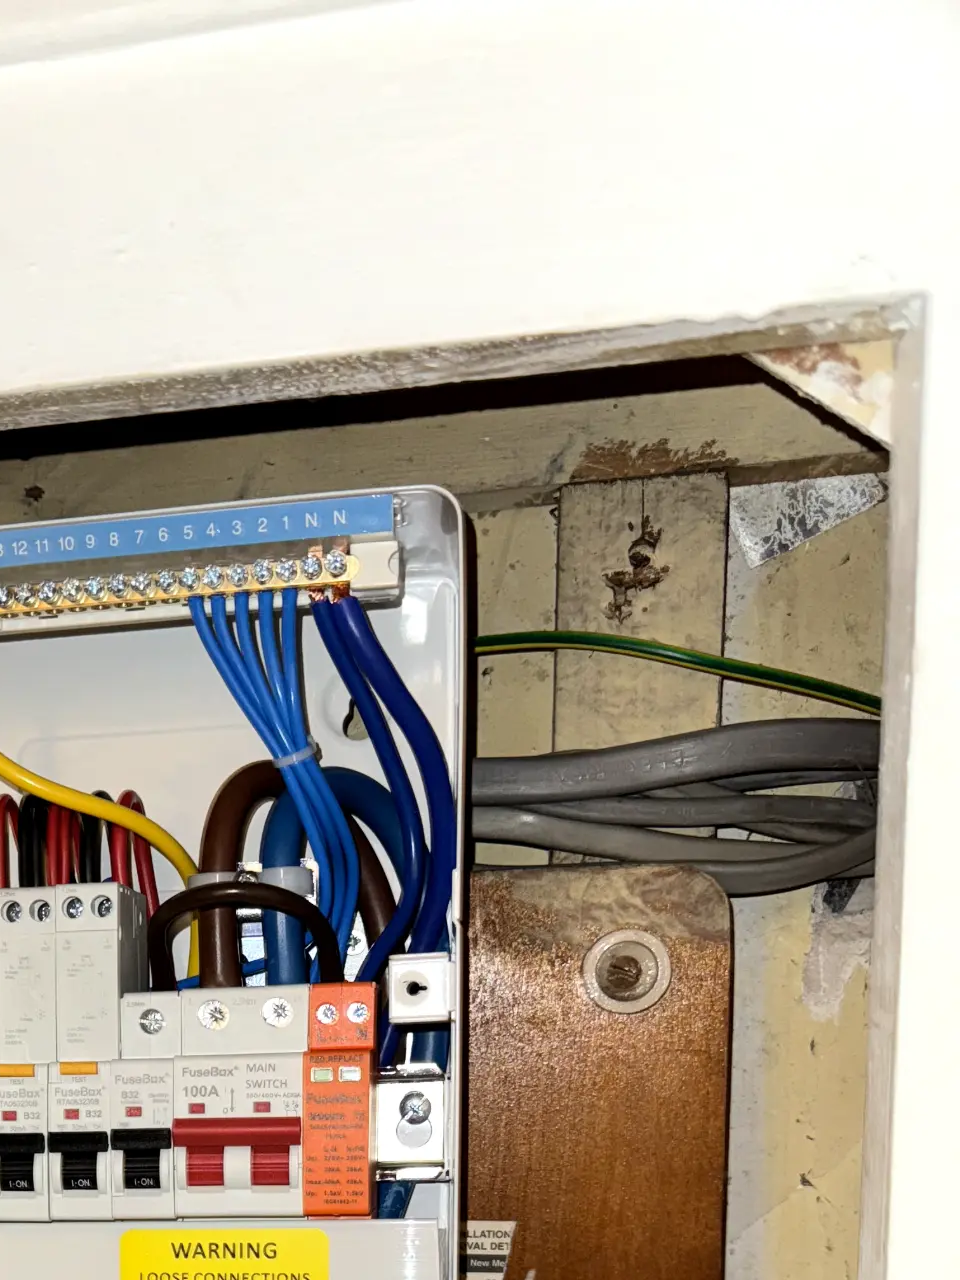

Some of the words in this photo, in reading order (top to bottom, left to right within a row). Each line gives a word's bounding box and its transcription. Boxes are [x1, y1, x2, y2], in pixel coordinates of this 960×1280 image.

[12, 540, 28, 555] 12
[36, 538, 49, 553] 11
[58, 536, 75, 551] 10
[85, 534, 95, 549] 9
[109, 532, 119, 546] 8
[134, 529, 144, 544] 7
[158, 527, 168, 542] 6
[183, 525, 193, 540] 5
[206, 522, 215, 537] 4
[232, 520, 242, 535] 3
[258, 517, 268, 532] 2
[282, 515, 289, 530] 1
[305, 512, 318, 528] N
[333, 509, 346, 525] N
[182, 1067, 235, 1077] FuseBox
[246, 1063, 276, 1073] MAIN
[245, 1079, 288, 1089] SWITCH
[121, 1091, 139, 1099] B32
[182, 1085, 220, 1098] 100A
[23, 1112, 40, 1120] B32
[85, 1110, 102, 1118] B32
[171, 1242, 278, 1259] WARNING
[470, 1259, 489, 1267] New
